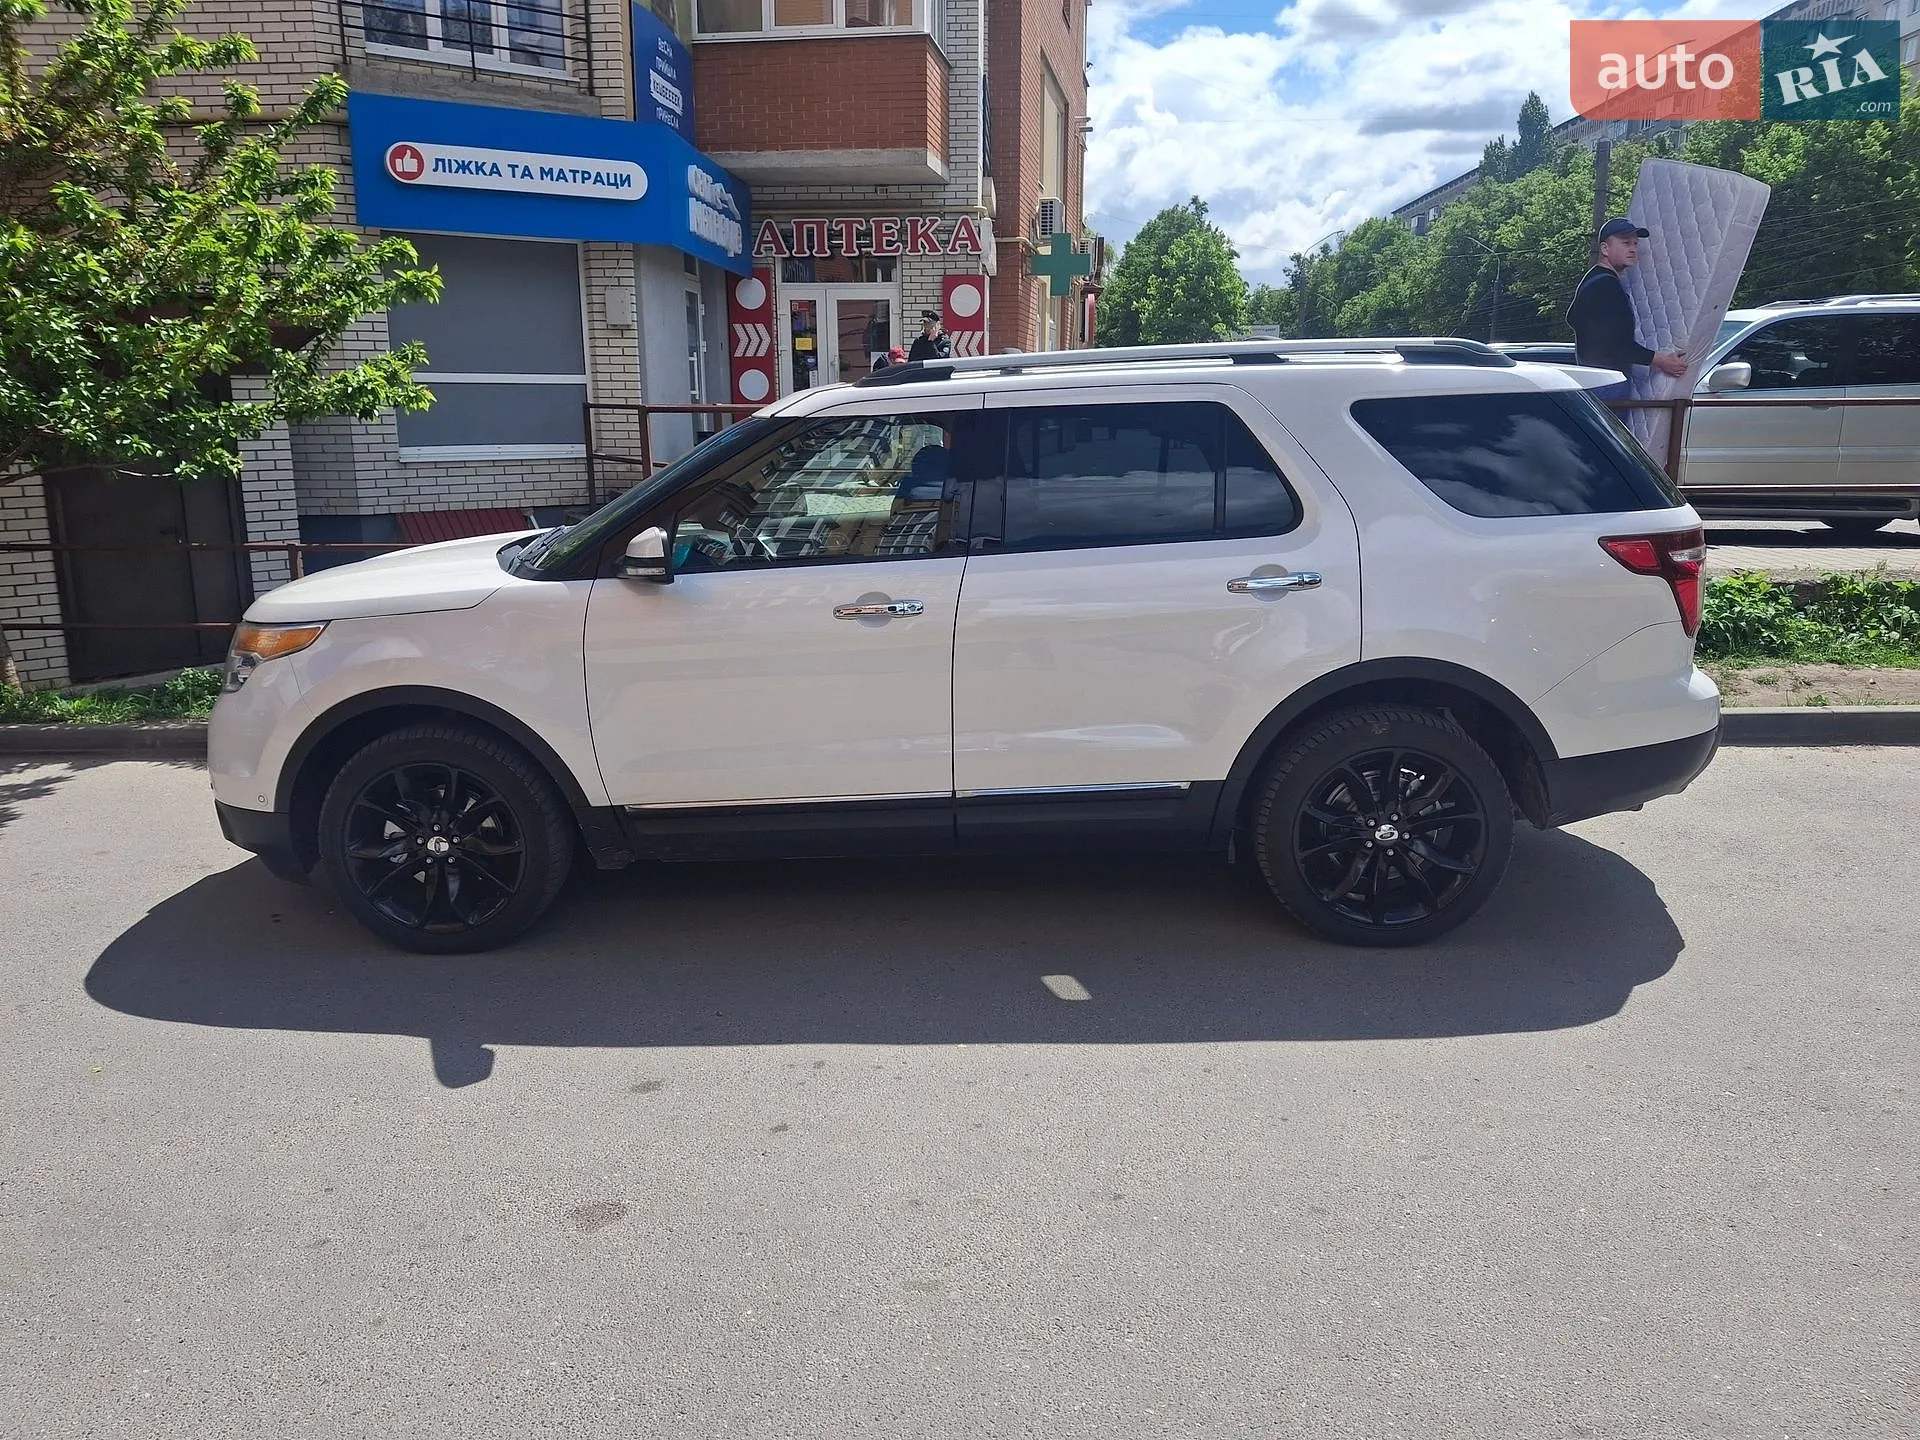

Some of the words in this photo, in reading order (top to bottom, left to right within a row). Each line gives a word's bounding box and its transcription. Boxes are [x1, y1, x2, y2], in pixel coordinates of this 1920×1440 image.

[432, 157, 502, 178] ЛІЖКА
[507, 163, 534, 180] ТА
[539, 166, 632, 190] МАТРАЦИ
[752, 215, 983, 258] АПТЕКА
